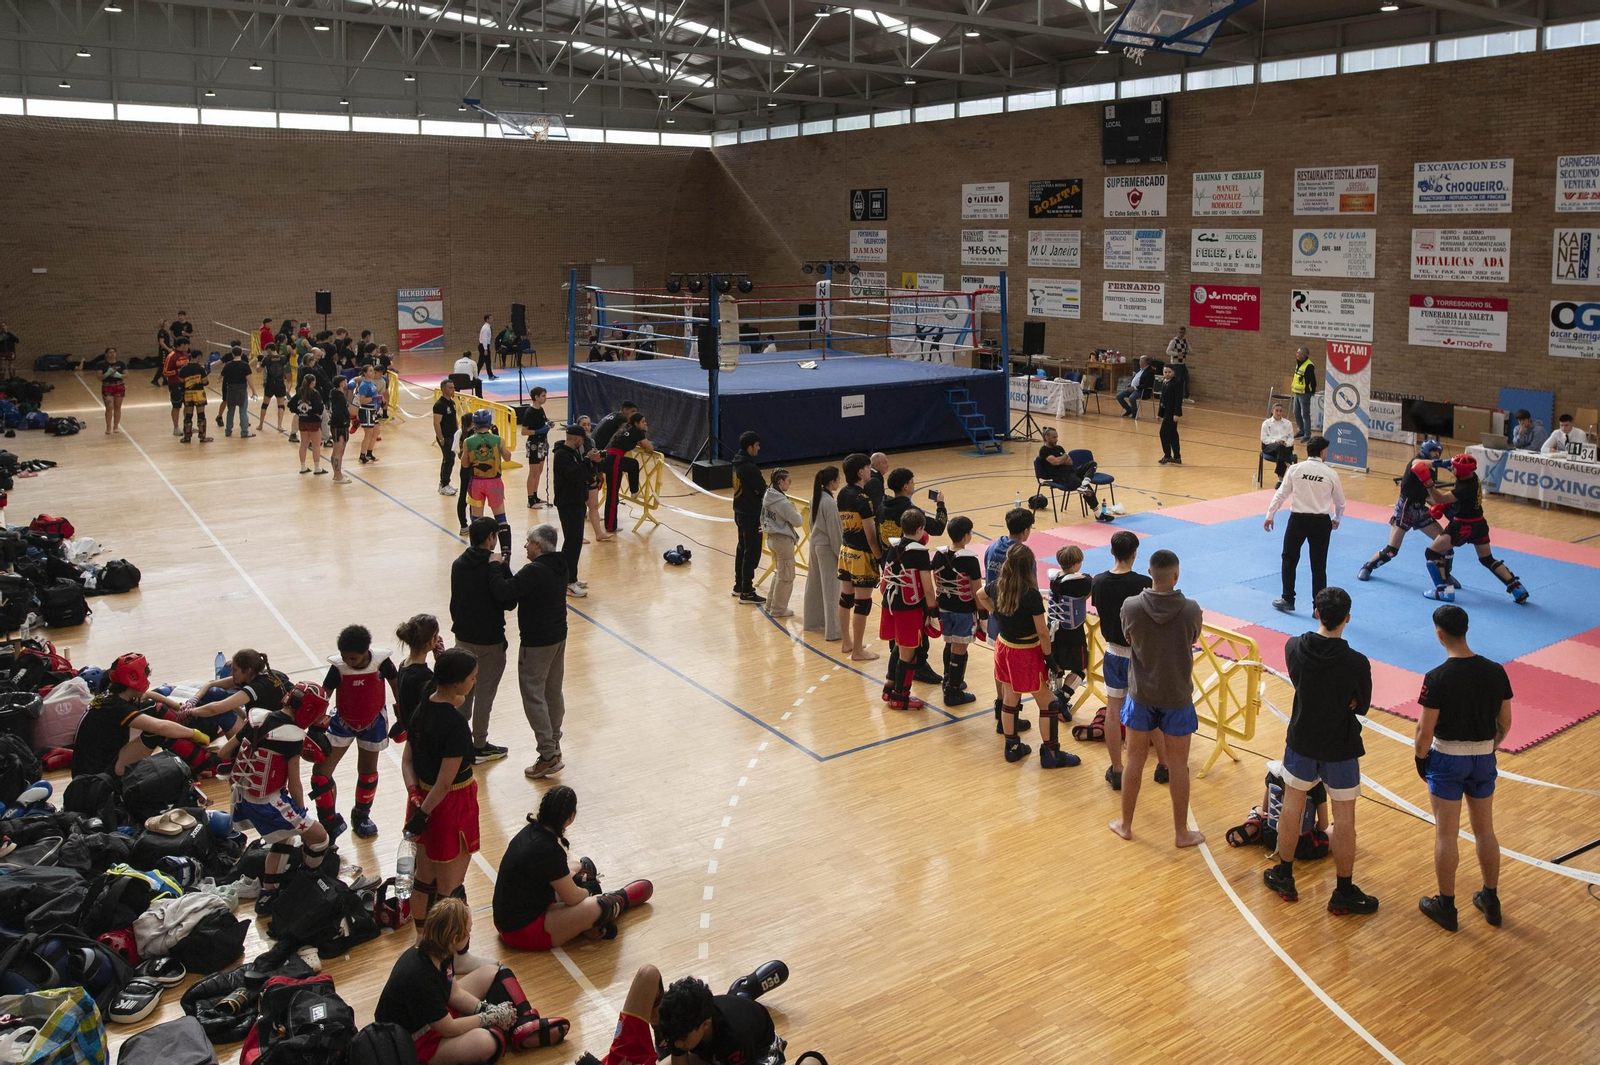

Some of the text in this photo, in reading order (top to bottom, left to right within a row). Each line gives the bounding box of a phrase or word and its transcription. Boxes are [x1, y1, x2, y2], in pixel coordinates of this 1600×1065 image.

[1418, 161, 1506, 172] EXCAVACIONES
[1232, 172, 1262, 180] CEREALES
[1297, 168, 1376, 180] RESTAURANTE HOSTAL ATENEO
[1560, 169, 1599, 178] SECUNDINO
[1106, 176, 1165, 188] SUPERMERCADO
[1446, 180, 1503, 192] CHOQUEIRO
[1564, 180, 1596, 188] VENTURA
[1033, 184, 1081, 215] LOLITA
[1324, 232, 1336, 240] SOL
[968, 246, 1002, 255] MESON
[1030, 245, 1038, 256] M.
[1050, 245, 1078, 256] Janeiro
[1416, 256, 1474, 267] METALICAS
[1108, 282, 1160, 292] FERNANDO
[1222, 292, 1257, 302] mapfre
[1421, 310, 1458, 319] FUNERARIA
[1469, 313, 1494, 321] SALETA
[1456, 340, 1492, 348] mapfre
[1332, 344, 1368, 356] TATAMI
[1344, 356, 1351, 371] 1
[1369, 406, 1395, 414] GALLEGA
[1581, 449, 1594, 460] 34
[1485, 464, 1600, 500] KCKBOXING
